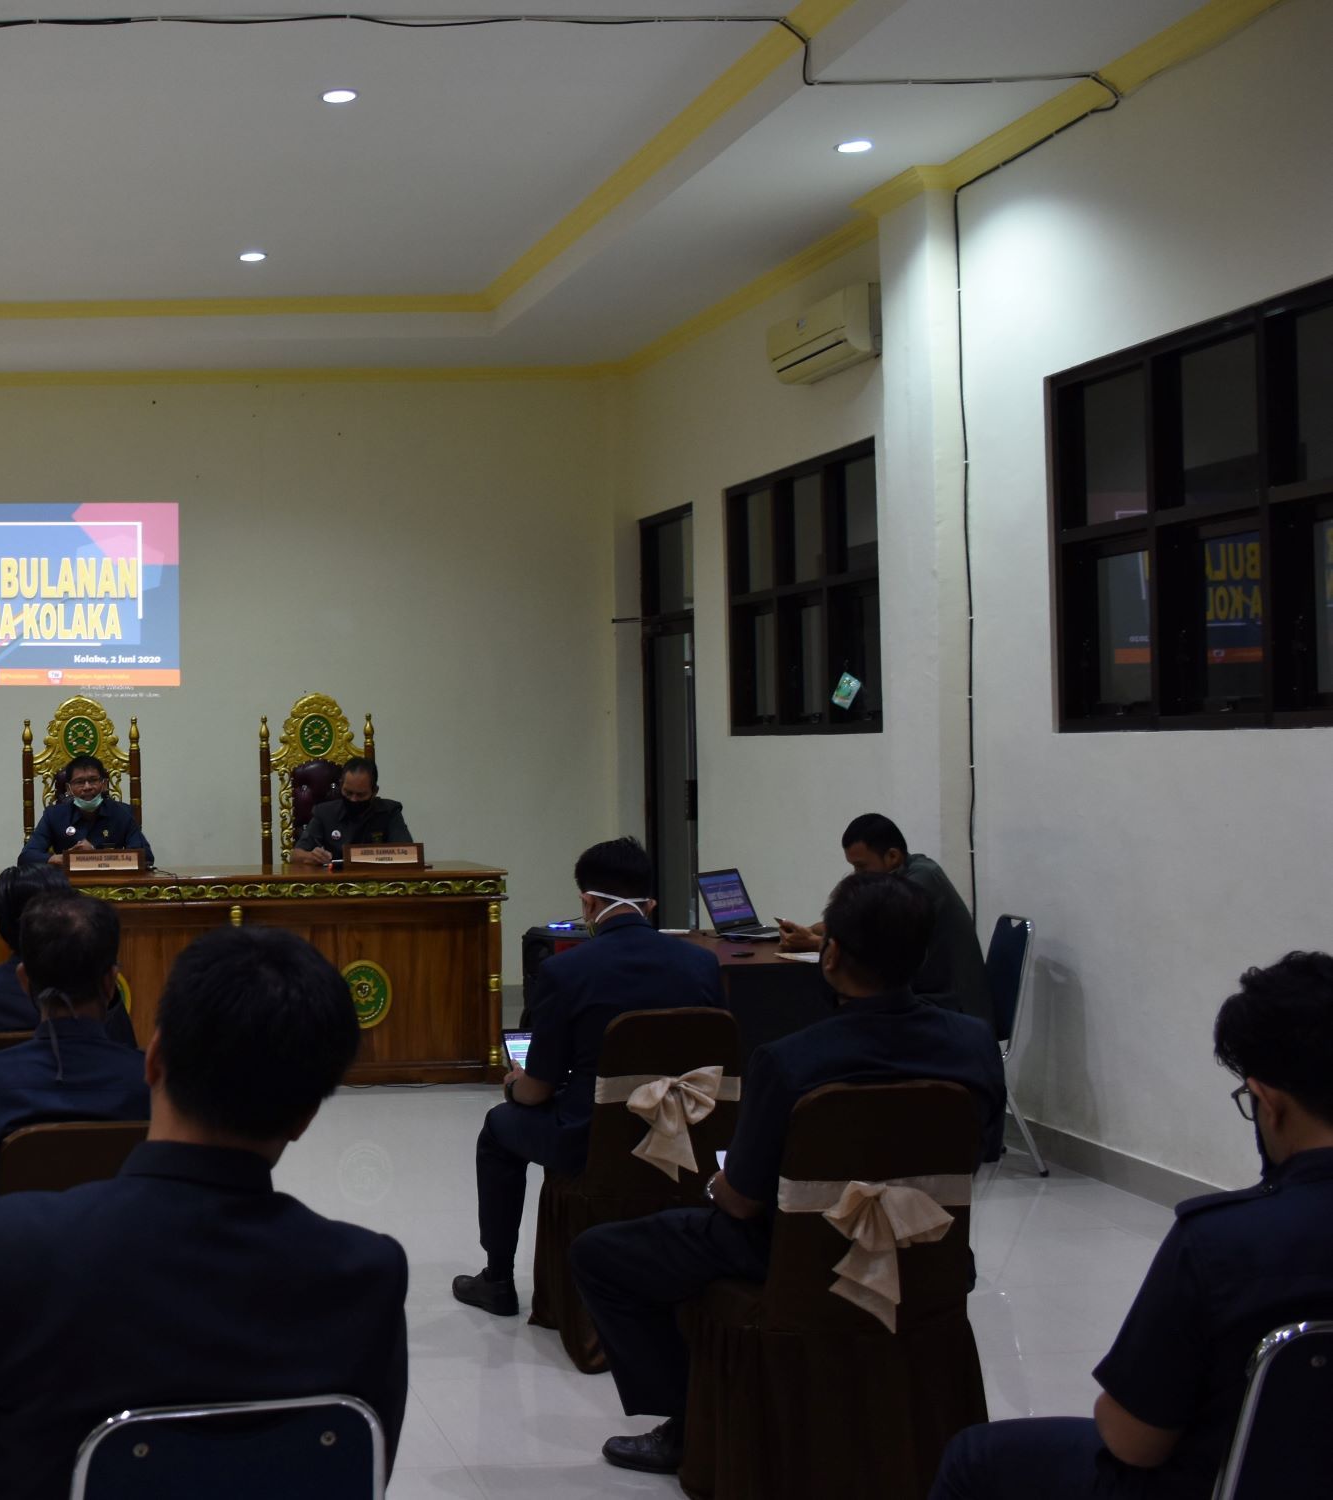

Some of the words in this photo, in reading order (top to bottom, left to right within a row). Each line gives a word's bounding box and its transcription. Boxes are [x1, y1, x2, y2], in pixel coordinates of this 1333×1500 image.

[0, 557, 138, 599] BULANAN
[23, 603, 122, 640] KOLAKA
[110, 656, 117, 664] 2
[118, 655, 136, 664] Juni
[137, 656, 162, 664] 2020
